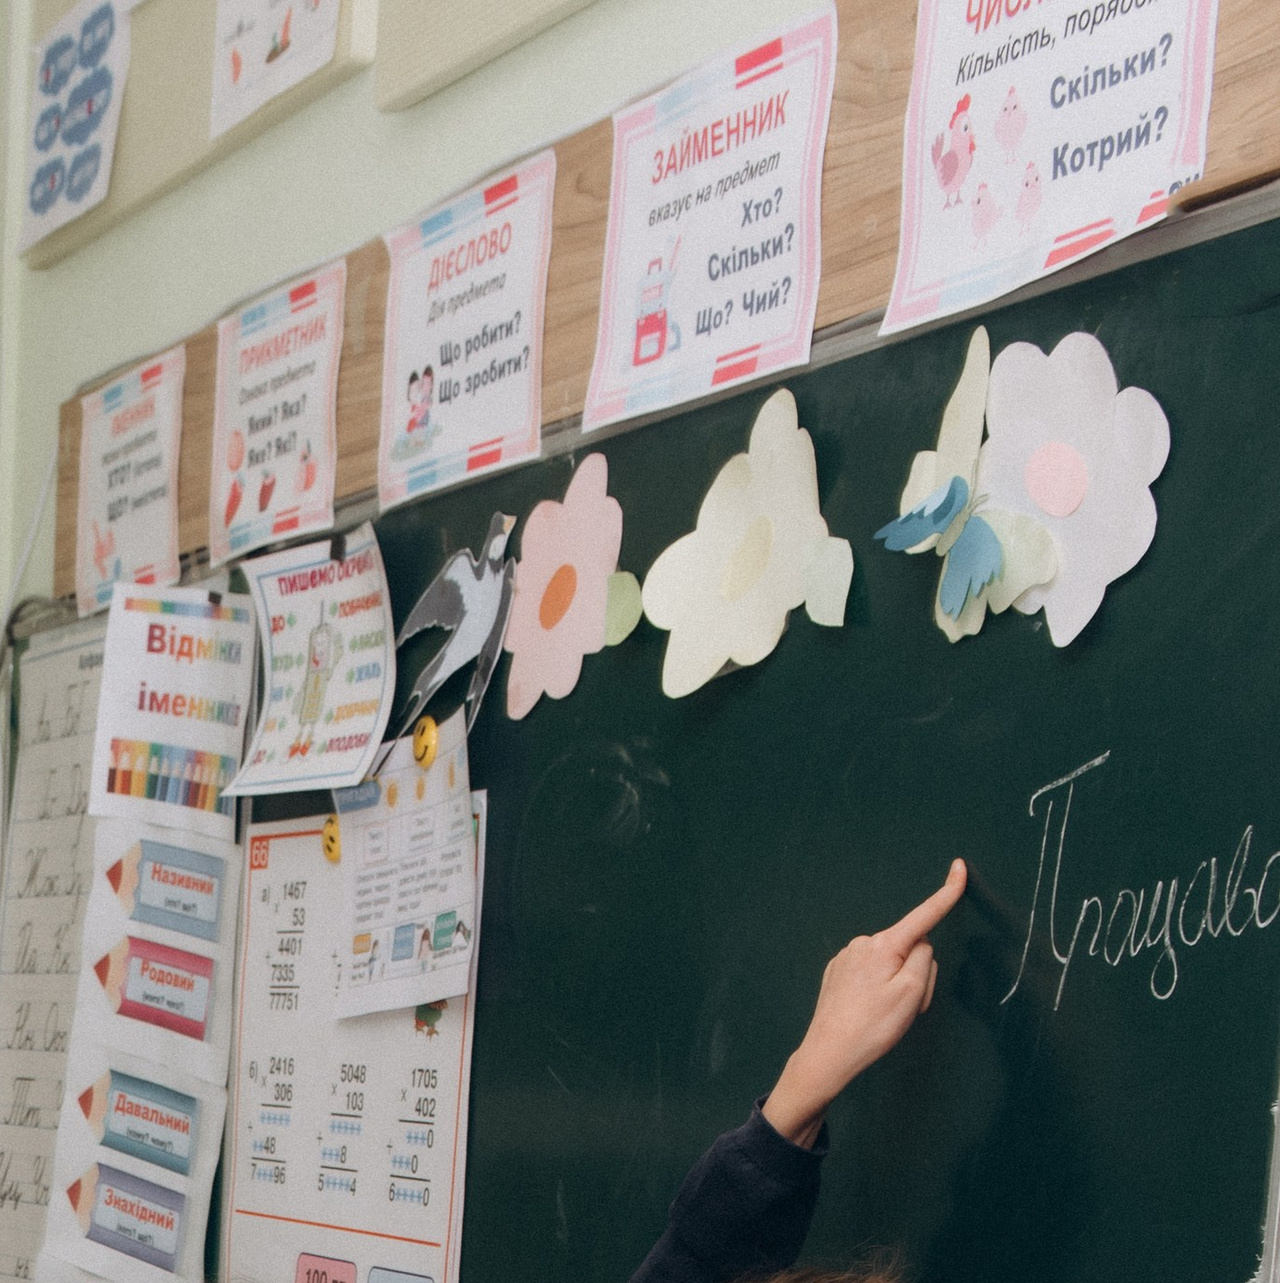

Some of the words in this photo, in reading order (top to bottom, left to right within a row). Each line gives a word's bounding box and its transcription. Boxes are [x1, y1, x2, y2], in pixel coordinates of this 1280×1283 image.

[955, 27, 1056, 86] Кількість,
[1050, 33, 1173, 109] Скільки?
[651, 89, 790, 185] ЗАЙМЕННИК
[1052, 106, 1169, 181] Котрий?
[648, 193, 692, 227] вказує
[696, 184, 712, 206] на
[715, 151, 781, 202] предмет
[741, 187, 783, 228] Хто?
[426, 221, 512, 297] ДІЄСЛОВО
[708, 222, 795, 283] Скільки?
[695, 299, 734, 337] Що?
[742, 275, 792, 318] Чий?
[440, 338, 461, 368] Що
[465, 310, 522, 362] робити?
[439, 377, 460, 406] Що
[465, 344, 530, 397] зробити?
[252, 841, 268, 867] 66
[151, 861, 215, 897] Називний
[283, 882, 307, 900] 1467
[293, 908, 306, 927] 53
[279, 939, 303, 957] 4401
[140, 958, 195, 993] Родовий
[271, 964, 295, 983] 7335
[270, 993, 299, 1011] 77751
[270, 1057, 295, 1076] 2416
[340, 1064, 367, 1084] 5048
[412, 1069, 438, 1089] 1705
[274, 1083, 293, 1102] 306
[346, 1092, 364, 1111] 103
[415, 1097, 437, 1118] 402
[114, 1092, 190, 1136] Давальний
[104, 1188, 175, 1232] Знахідний
